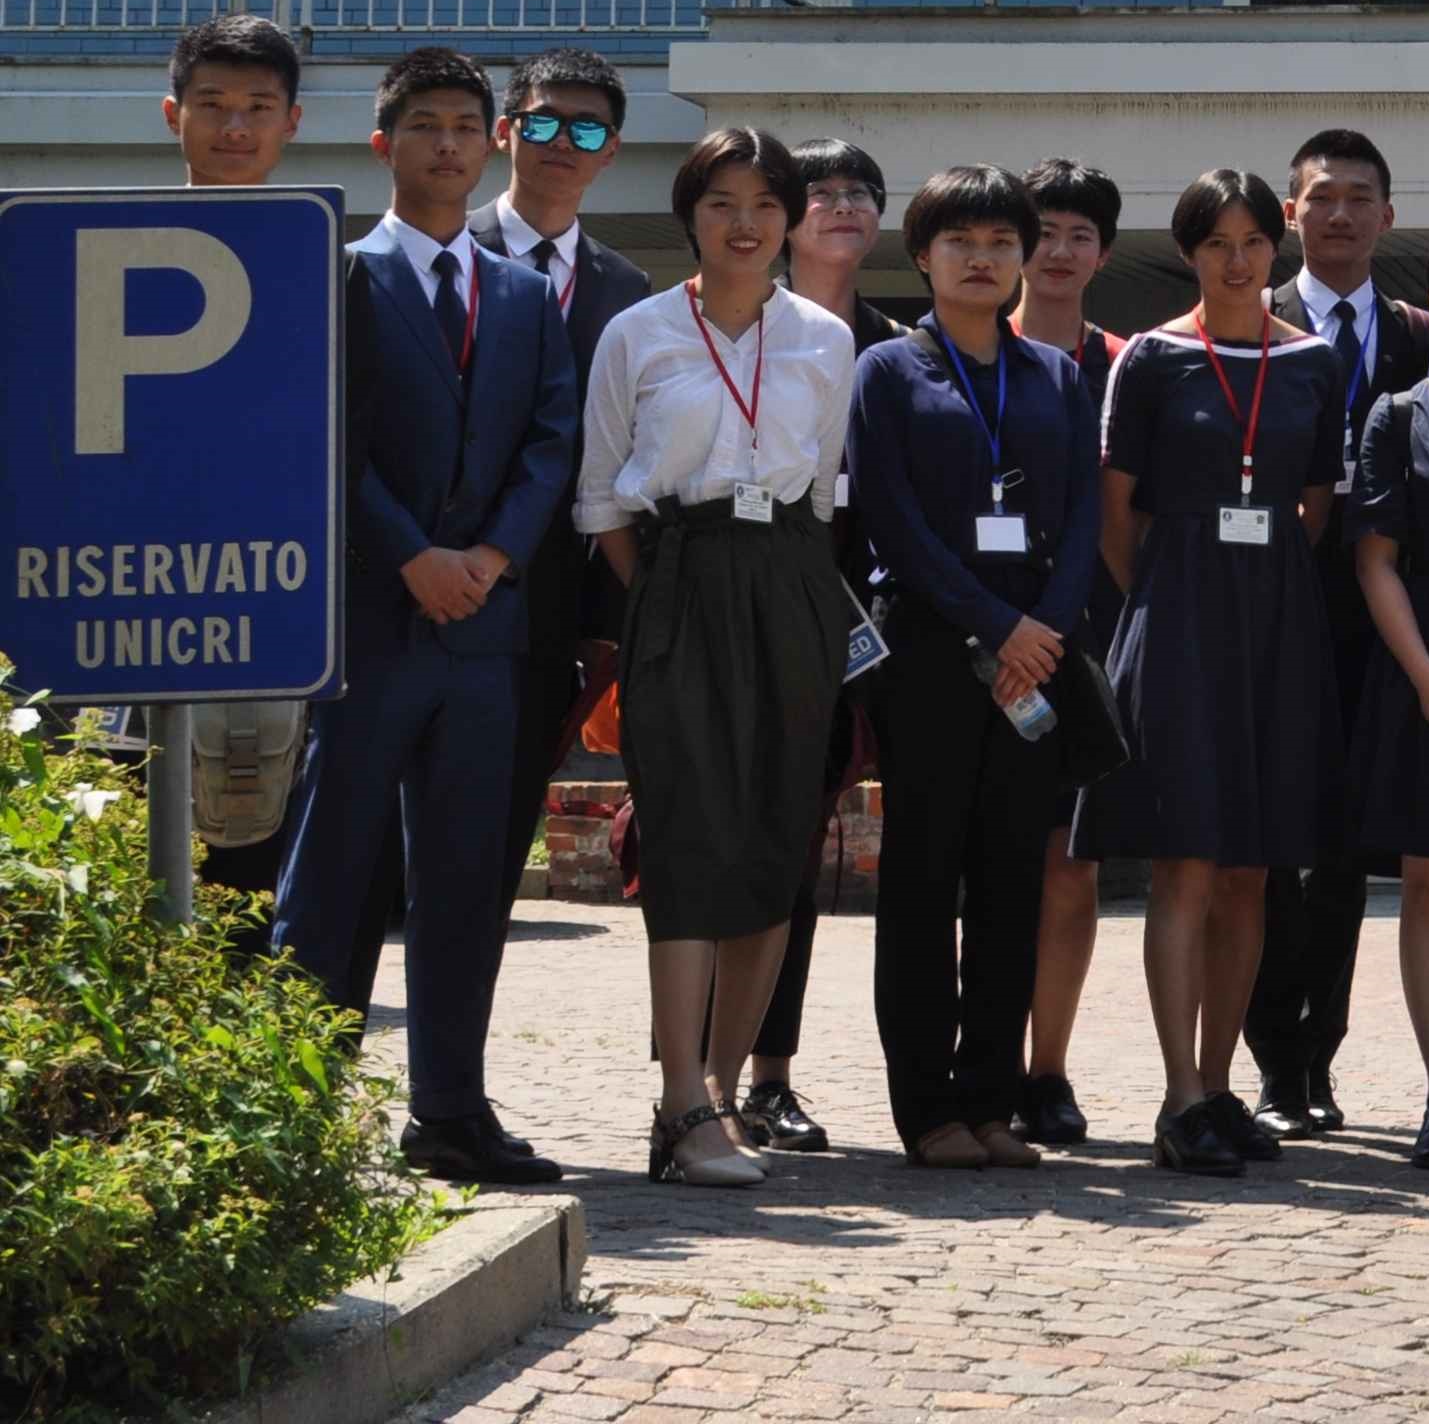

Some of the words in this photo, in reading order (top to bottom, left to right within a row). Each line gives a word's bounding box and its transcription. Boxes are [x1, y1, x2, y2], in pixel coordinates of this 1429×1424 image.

[75, 227, 252, 455] P
[17, 540, 308, 599] RISERVATO
[76, 616, 252, 669] UNICRI
